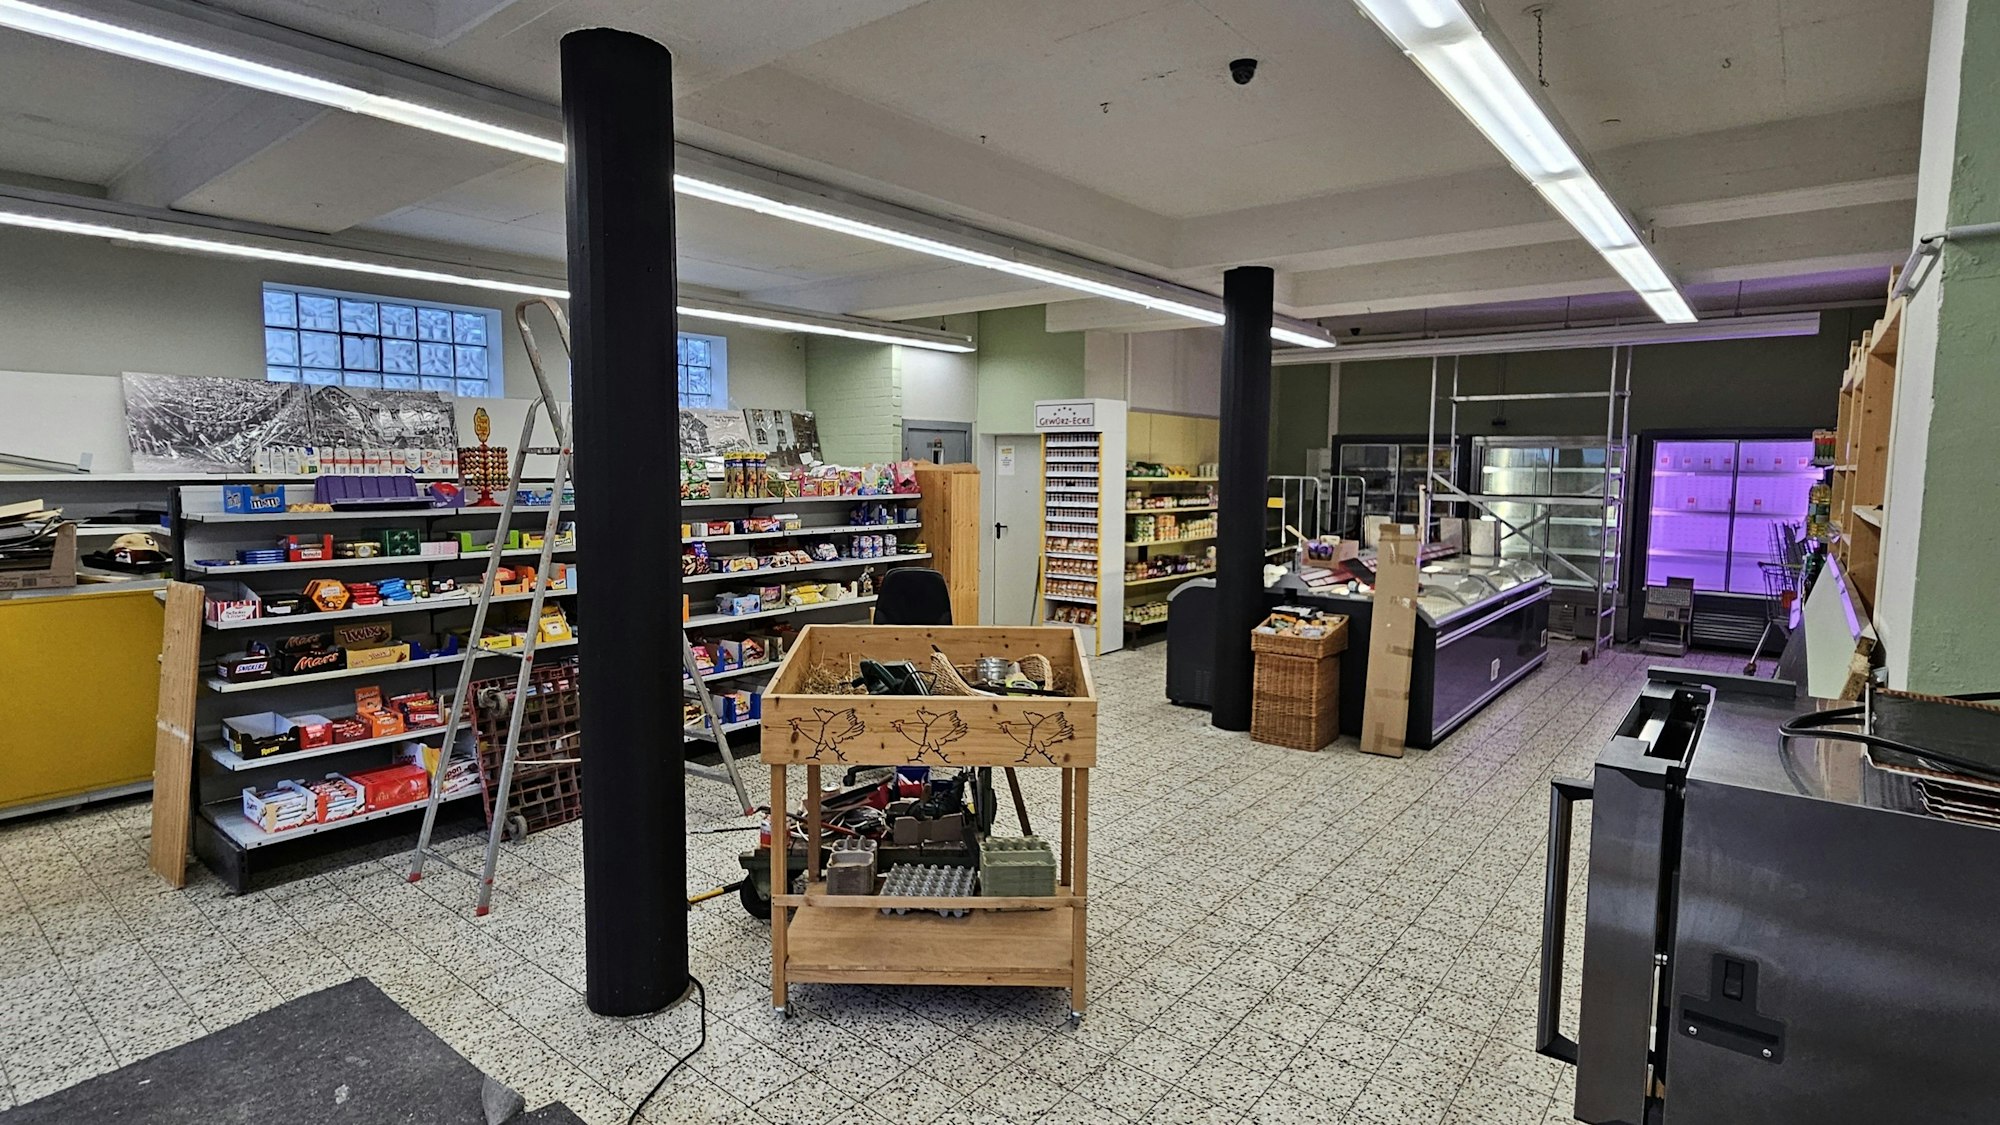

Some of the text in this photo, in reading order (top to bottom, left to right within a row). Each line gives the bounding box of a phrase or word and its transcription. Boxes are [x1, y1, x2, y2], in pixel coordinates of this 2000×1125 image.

[285, 634, 320, 648] Mars
[236, 662, 268, 674] SNICKERS
[294, 652, 339, 672] Mars
